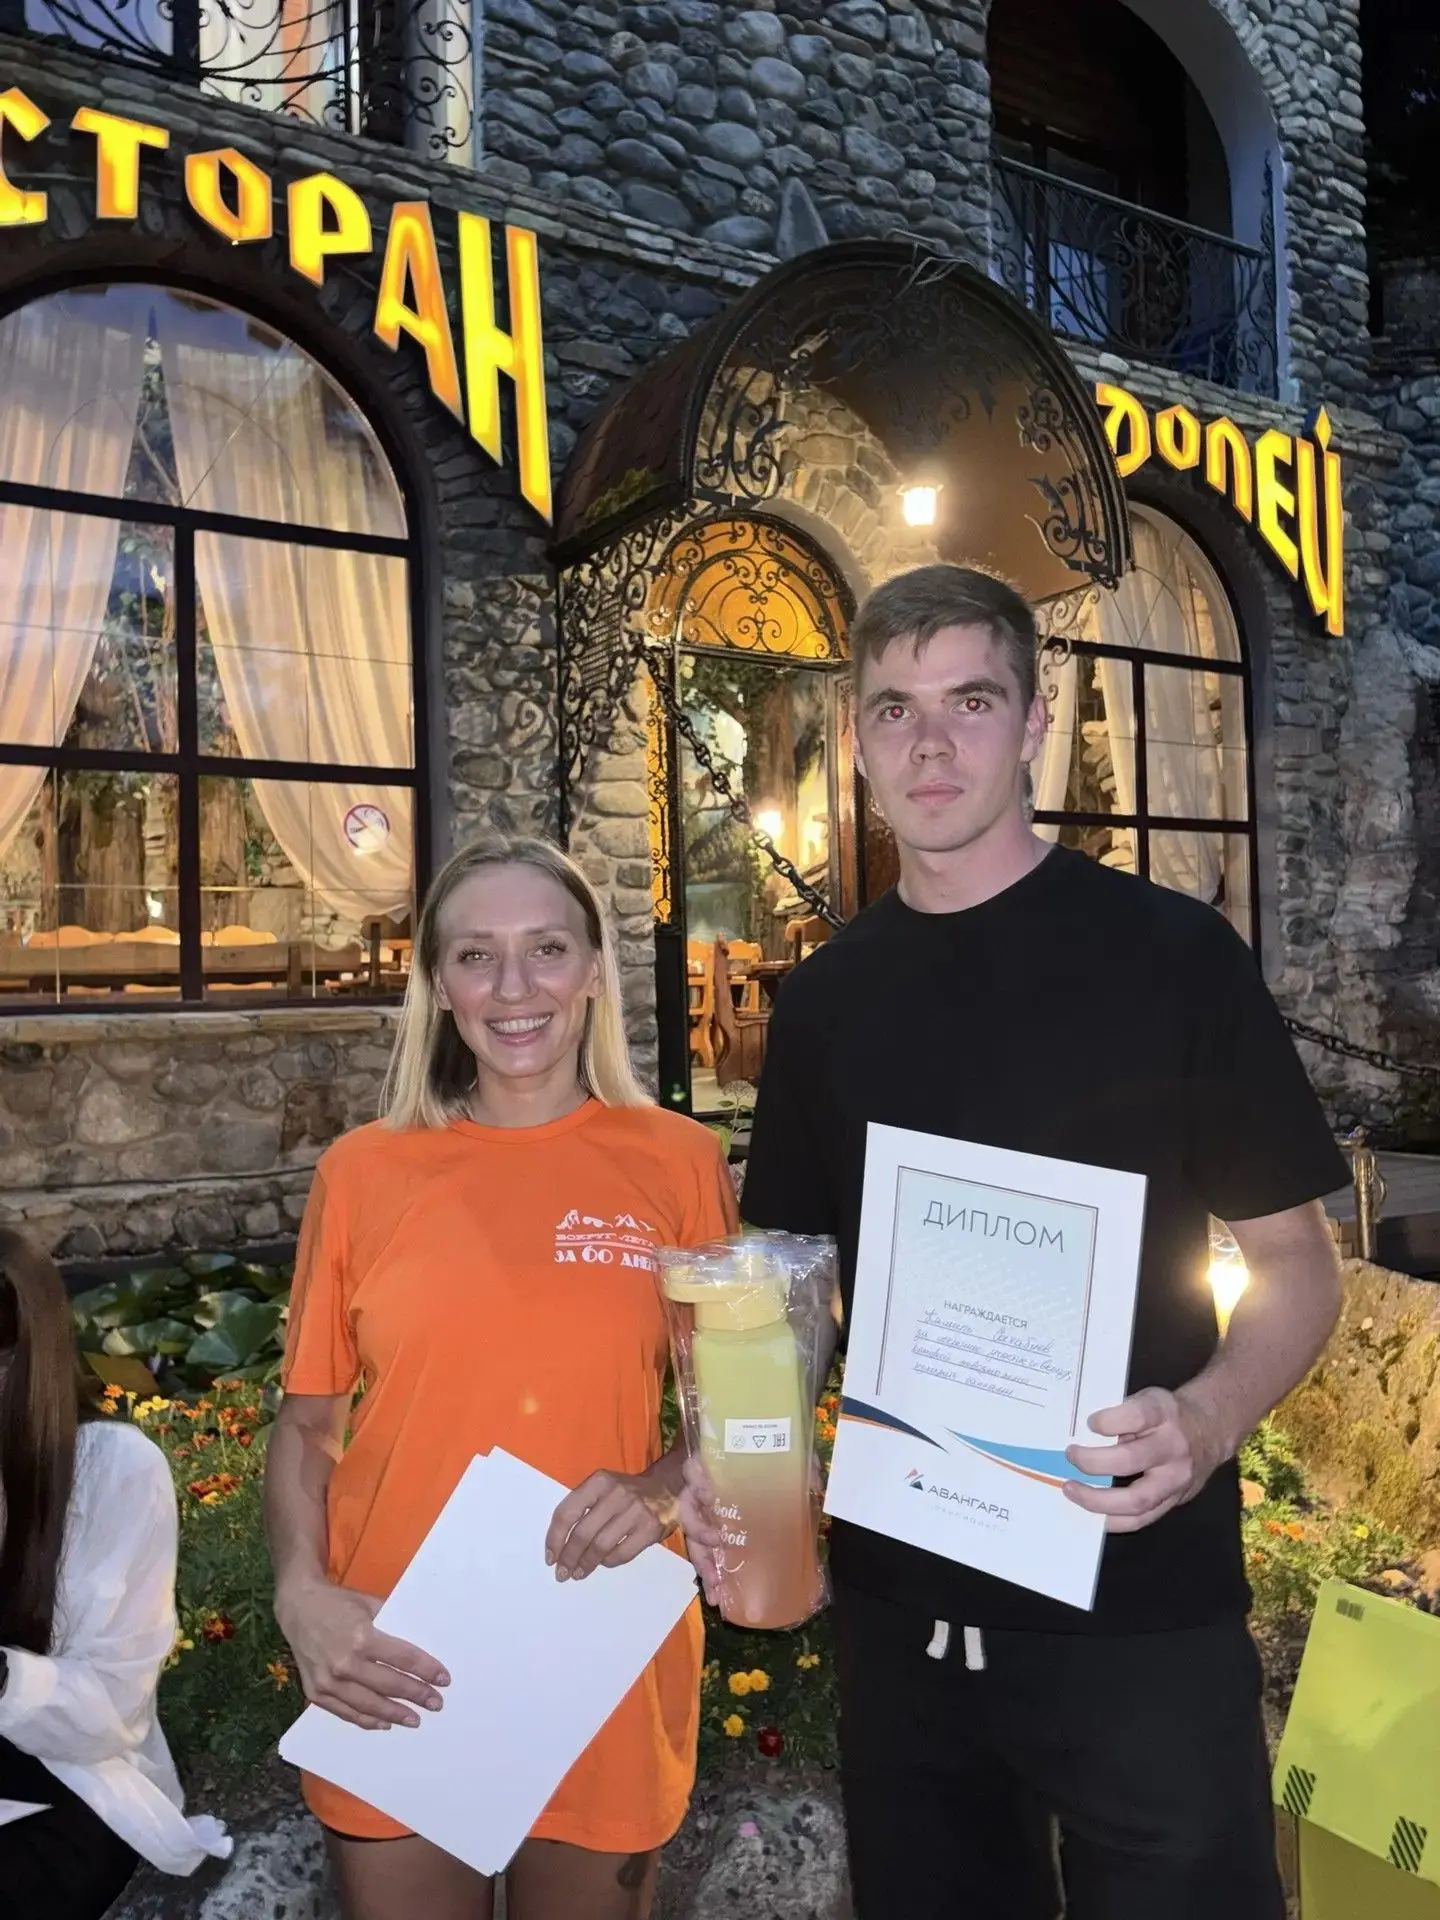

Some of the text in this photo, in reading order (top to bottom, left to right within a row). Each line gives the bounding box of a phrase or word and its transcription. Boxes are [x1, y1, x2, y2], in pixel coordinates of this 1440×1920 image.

[922, 1199, 1065, 1254] ДИПЛОМ
[554, 1249, 577, 1263] ЗА
[943, 1300, 1028, 1330] НАГРАЖДАЕТСЯ
[927, 1485, 1010, 1521] АВАНГАРД
